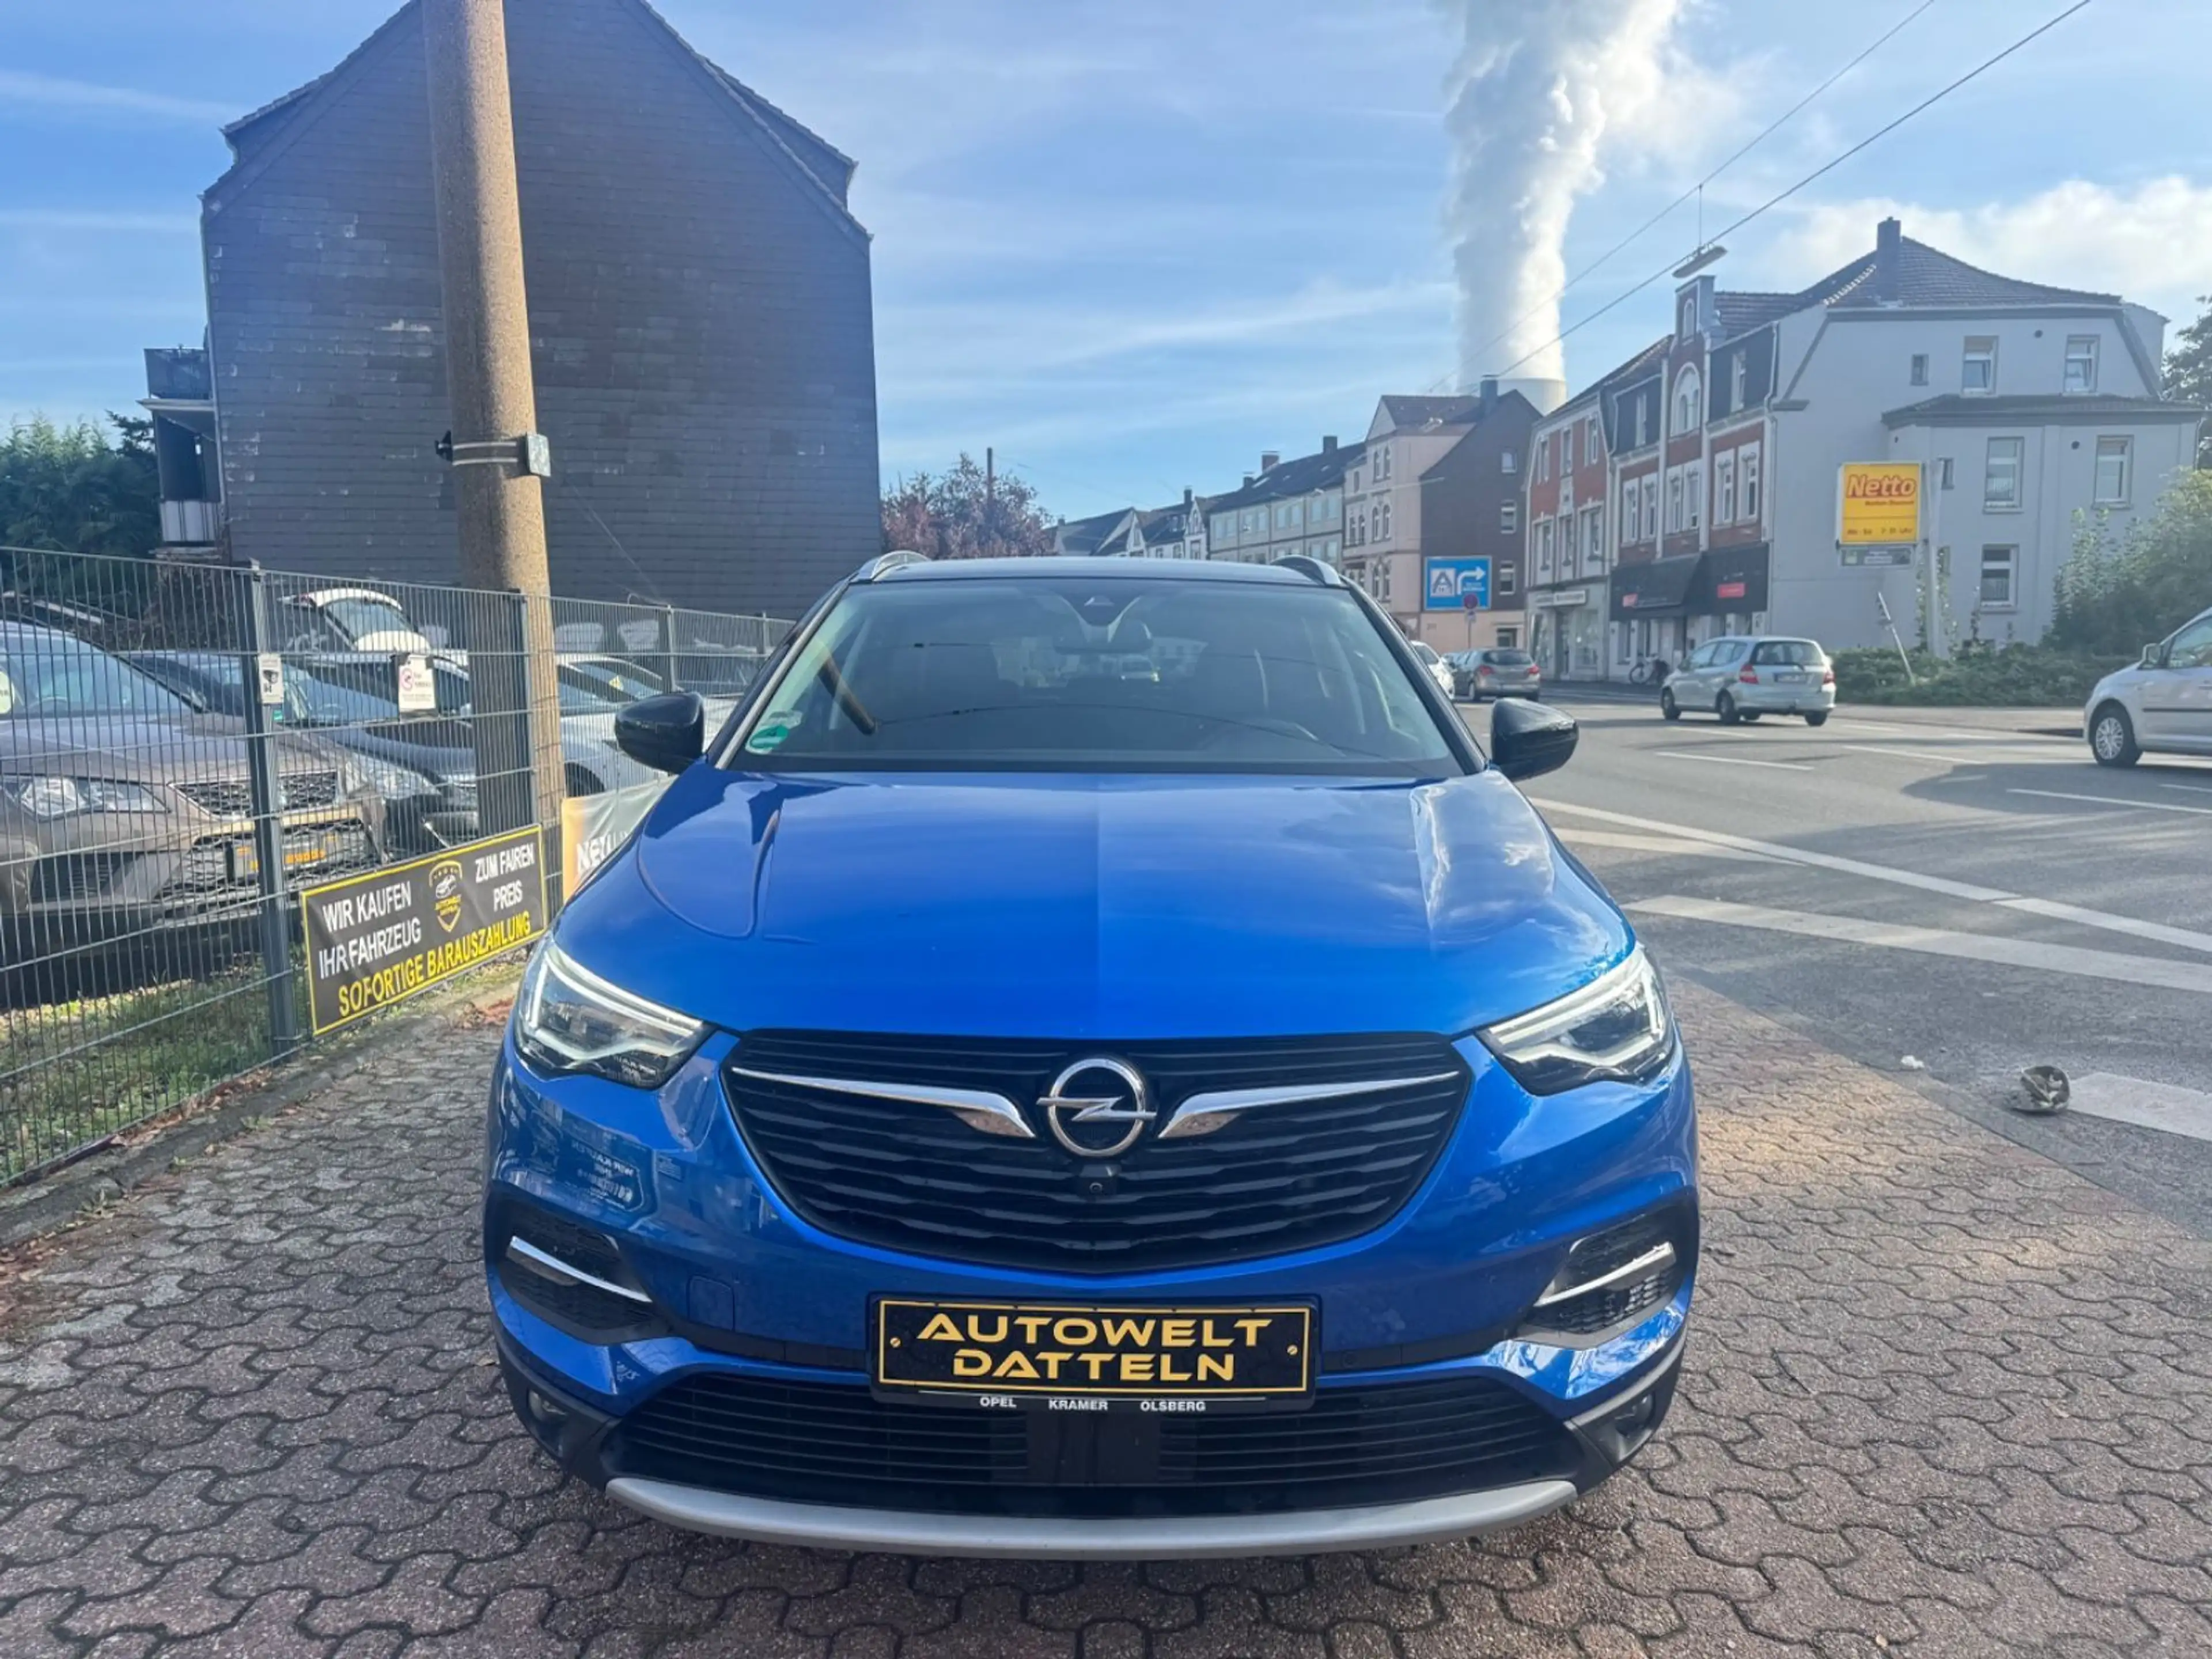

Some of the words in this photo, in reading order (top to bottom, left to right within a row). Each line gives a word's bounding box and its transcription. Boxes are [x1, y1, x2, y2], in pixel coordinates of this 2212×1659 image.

[1846, 474, 1916, 498] Netto
[475, 853, 499, 883] ZUM
[500, 842, 535, 874] FAIREN
[322, 898, 354, 933] WIR
[355, 881, 412, 923] KAUFEN
[494, 880, 523, 912] PREIS
[319, 944, 349, 979] IHR
[349, 917, 422, 968] FAHRZEUG
[339, 954, 425, 1017] SOFORTIGE
[427, 910, 531, 978] BARAUSZAHLUNG
[916, 1313, 1274, 1348] AUTOWELT
[953, 1349, 1234, 1382] DATTELN
[979, 1396, 1017, 1408] OPEL
[1048, 1399, 1109, 1411] KRAMER
[1140, 1400, 1206, 1412] OLSBERG
